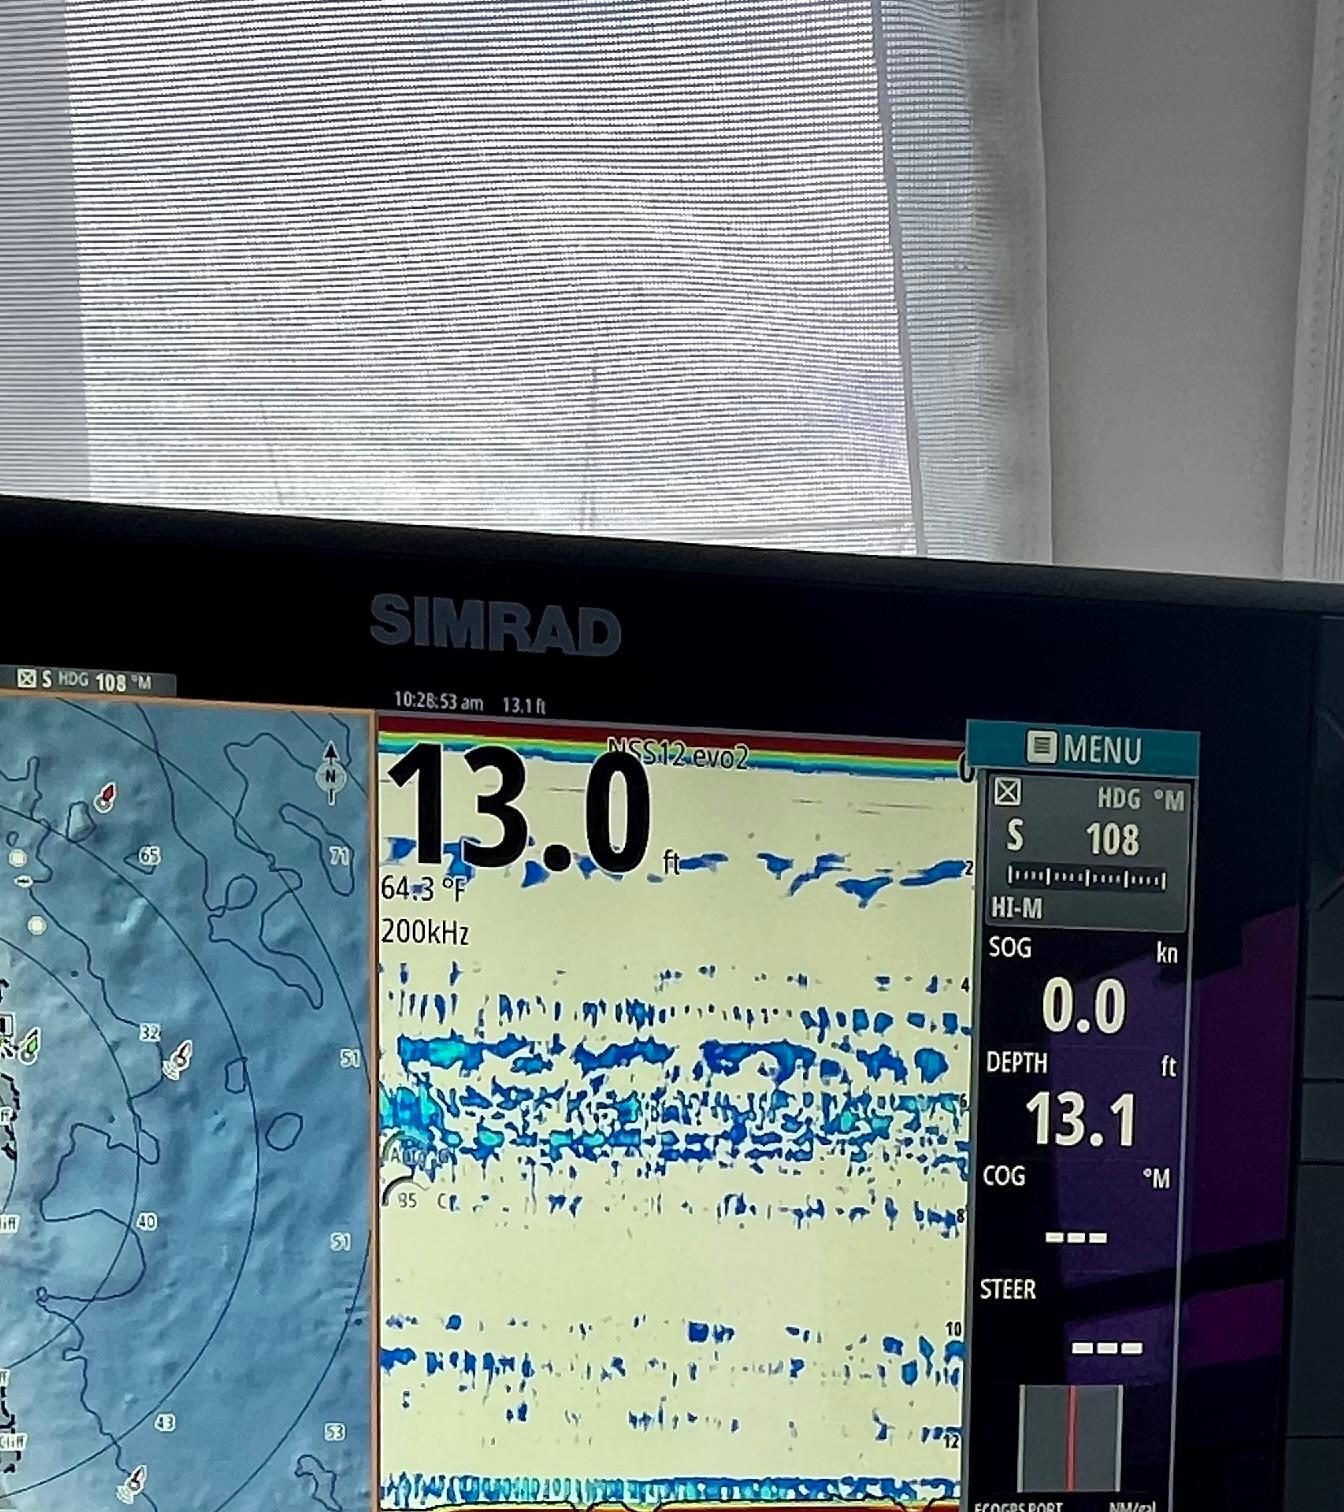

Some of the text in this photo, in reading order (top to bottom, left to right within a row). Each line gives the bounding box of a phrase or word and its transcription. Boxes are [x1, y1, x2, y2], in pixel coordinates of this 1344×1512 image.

[369, 593, 623, 657] SIMRAD
[42, 670, 52, 688] S
[58, 671, 89, 687] HDG
[95, 673, 126, 692] 108
[395, 690, 546, 715] 10:28:53 am 13.1 ft
[607, 737, 749, 770] NSS12 evo2
[1063, 734, 1142, 766] MENU
[325, 769, 336, 783] N
[387, 742, 680, 876] 13.0 ft
[1098, 787, 1141, 810] HDG
[1007, 818, 1140, 857] S 108
[140, 847, 160, 863] 65
[330, 847, 350, 864] 71
[381, 874, 434, 902] 64.3
[991, 897, 1044, 921] HI-M
[381, 918, 471, 948] 200kHz
[989, 936, 1178, 965] SOG kn
[1042, 975, 1126, 1034] 0.0
[141, 1024, 160, 1041] 32
[341, 1050, 360, 1067] 51
[987, 1051, 1177, 1078] DEPTH ft
[1026, 1091, 1136, 1148] 13.1
[983, 1165, 1026, 1187] COG
[138, 1214, 156, 1230] 40
[331, 1233, 350, 1250] 51
[980, 1278, 1037, 1301] STEER
[946, 1321, 962, 1337] 10
[943, 1434, 960, 1449] 12
